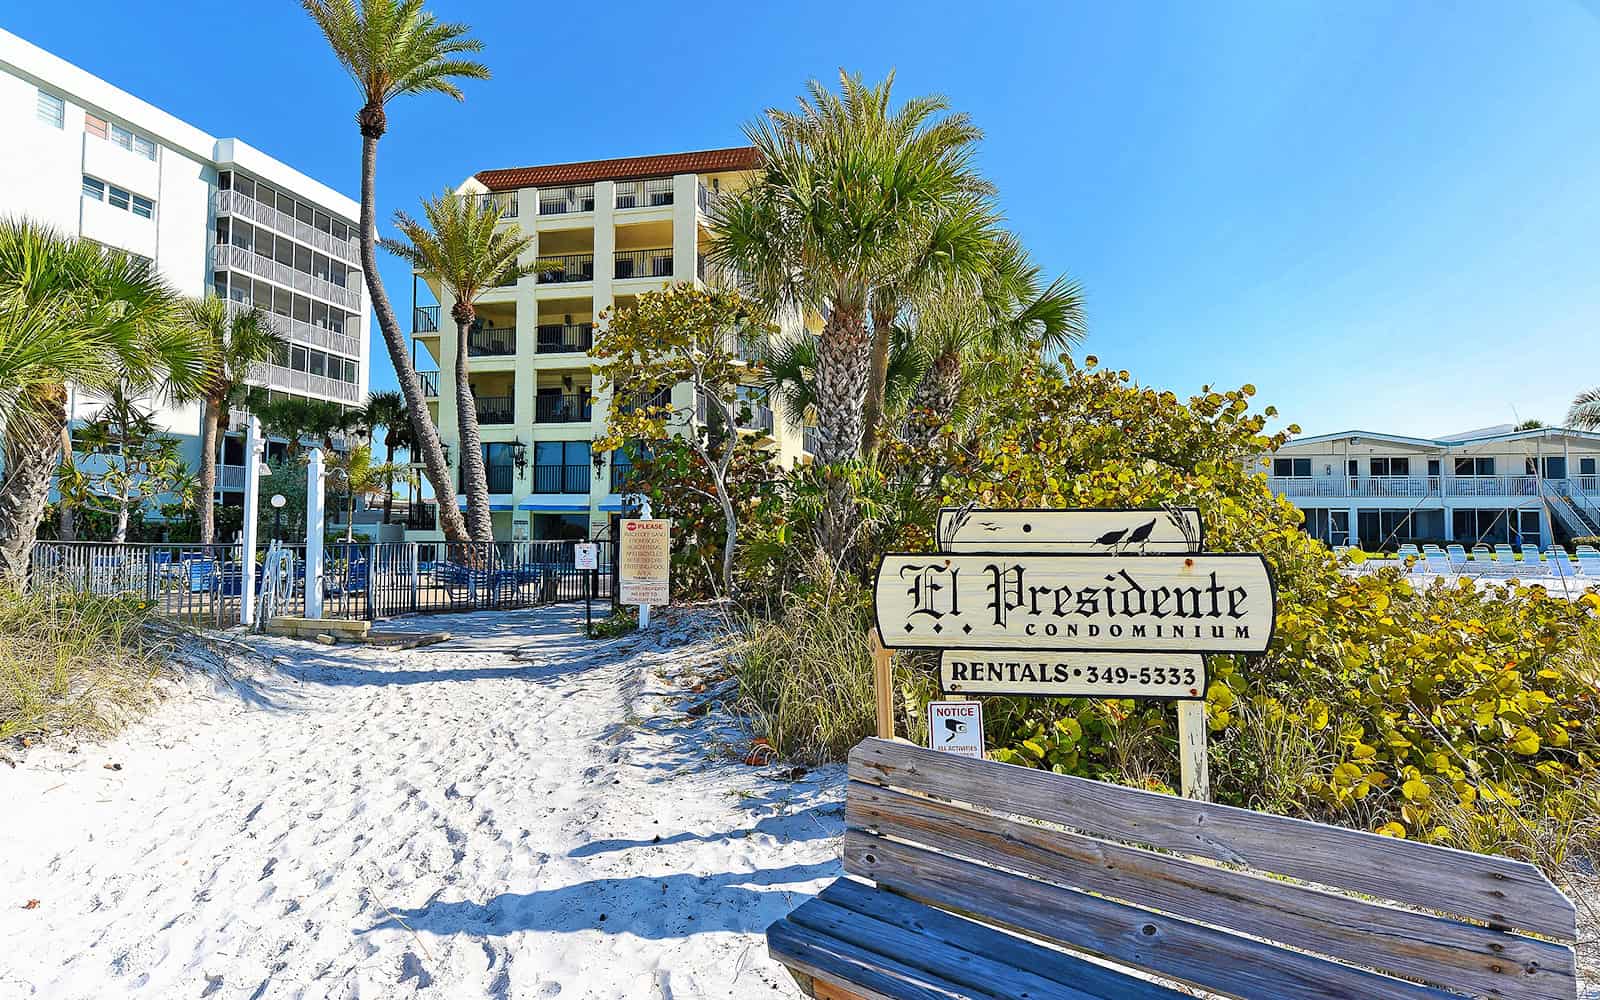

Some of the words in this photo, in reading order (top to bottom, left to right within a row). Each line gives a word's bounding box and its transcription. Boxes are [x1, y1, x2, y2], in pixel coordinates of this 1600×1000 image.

[900, 561, 961, 618] El
[983, 561, 1249, 629] Presidente
[1025, 624, 1250, 638] CONDOMINIUM
[936, 707, 975, 717] NOTICE
